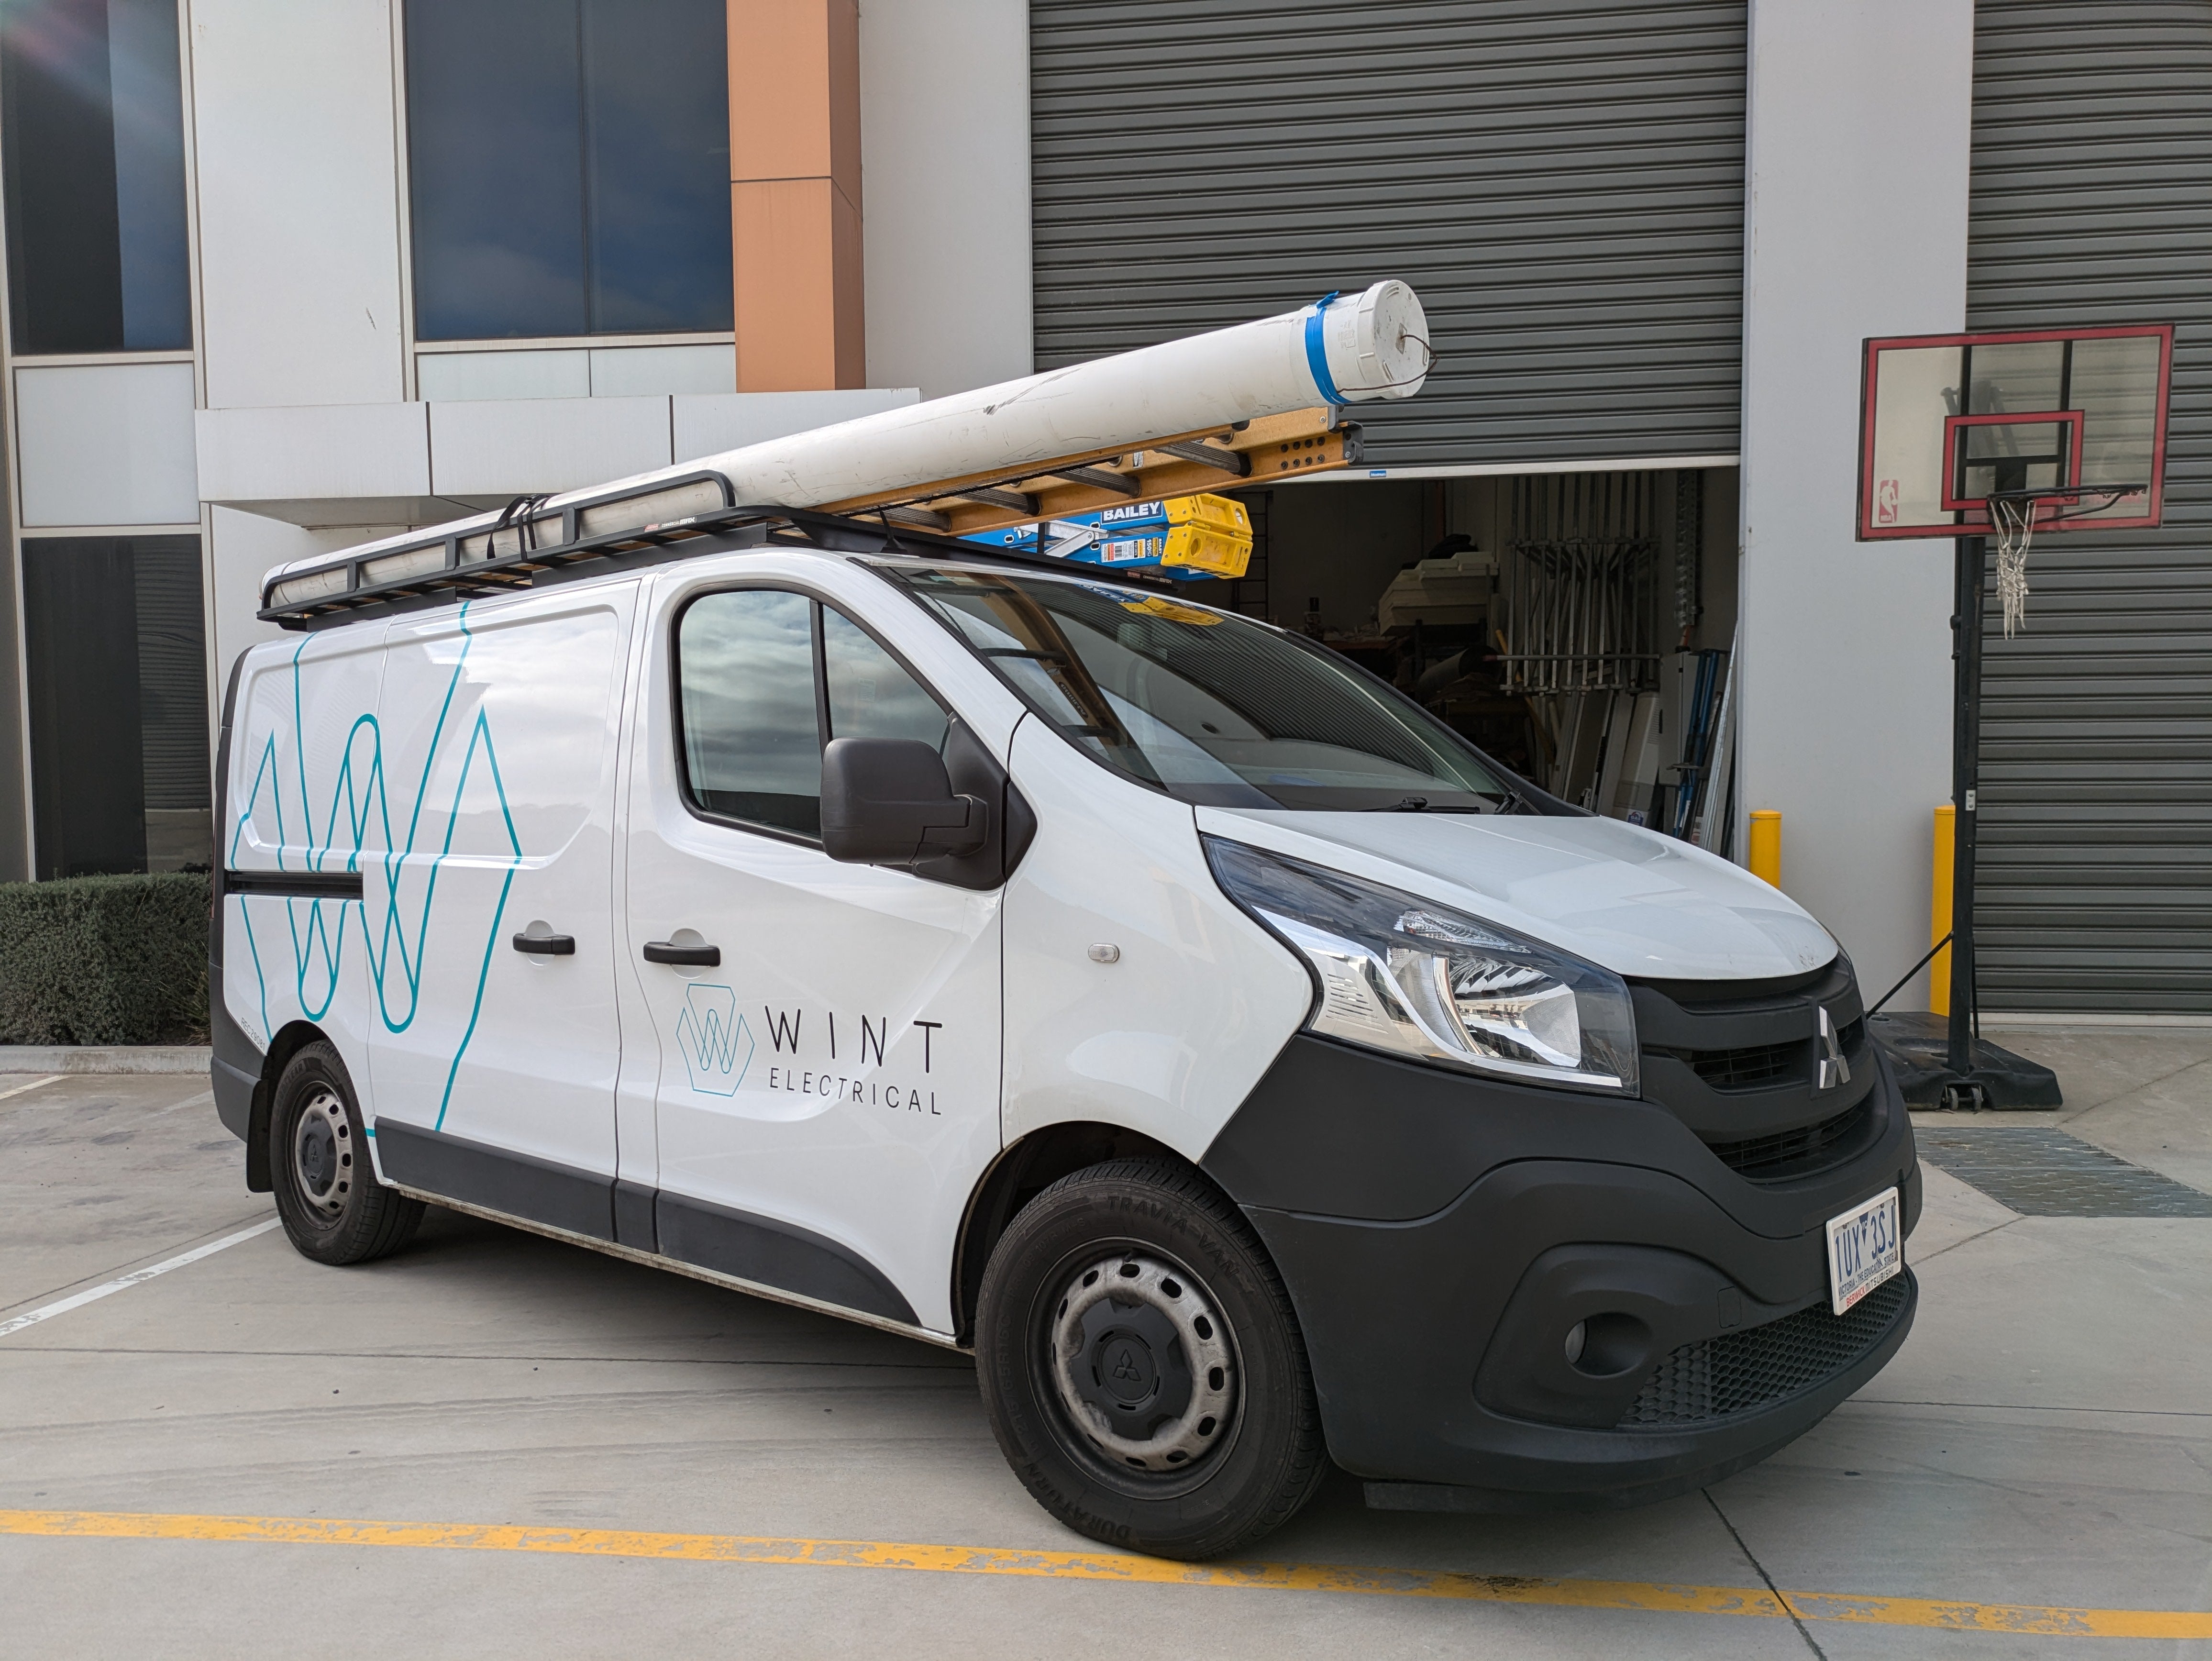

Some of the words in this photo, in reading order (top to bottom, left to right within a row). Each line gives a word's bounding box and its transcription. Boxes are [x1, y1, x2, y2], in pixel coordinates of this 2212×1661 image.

[680, 517, 695, 525] MAX
[1104, 501, 1160, 521] BAILEY
[241, 1017, 265, 1052] REC29081
[765, 1005, 942, 1073] WINT
[770, 1067, 941, 1115] ELECTRICAL
[1107, 1196, 1187, 1235] TRAVIA
[1198, 1232, 1239, 1279] VAN
[1835, 1224, 1861, 1283] 1UX
[1871, 1205, 1896, 1259] 3SJ
[1838, 1278, 1855, 1296] VICTORIA
[1864, 1258, 1883, 1279] EDUCATN
[1884, 1251, 1894, 1266] STATE
[1846, 1285, 1865, 1307] BERWICK
[1866, 1266, 1894, 1293] MITSUBISHI
[1023, 1462, 1132, 1539] DURATURN
